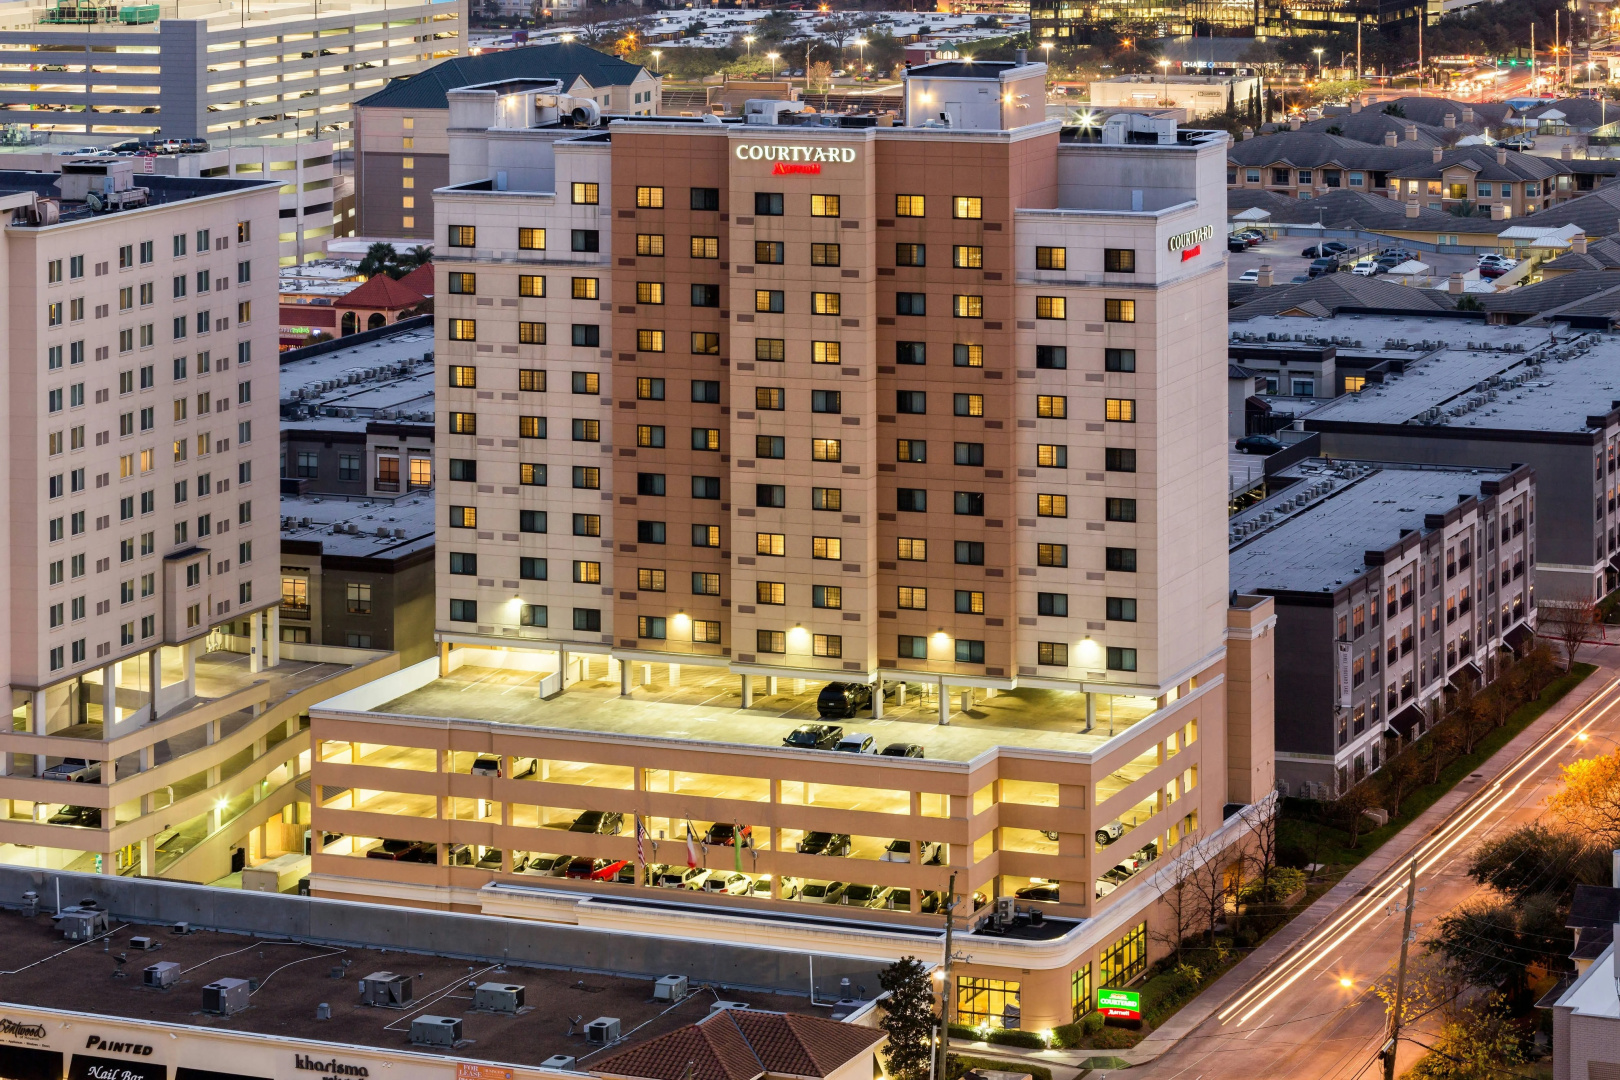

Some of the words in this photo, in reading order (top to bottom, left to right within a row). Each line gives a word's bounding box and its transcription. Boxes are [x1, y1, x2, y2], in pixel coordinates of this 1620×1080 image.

[736, 144, 856, 163] COURTYARD
[1169, 225, 1213, 251] COURTYARD
[1100, 998, 1137, 1007] COURTYARD
[86, 1035, 153, 1055] PAINTED
[88, 1066, 120, 1080] Nail
[121, 1070, 143, 1080] Bar
[295, 1054, 369, 1077] kharisma
[459, 1069, 482, 1078] LEASE
[463, 1064, 478, 1072] FOR
